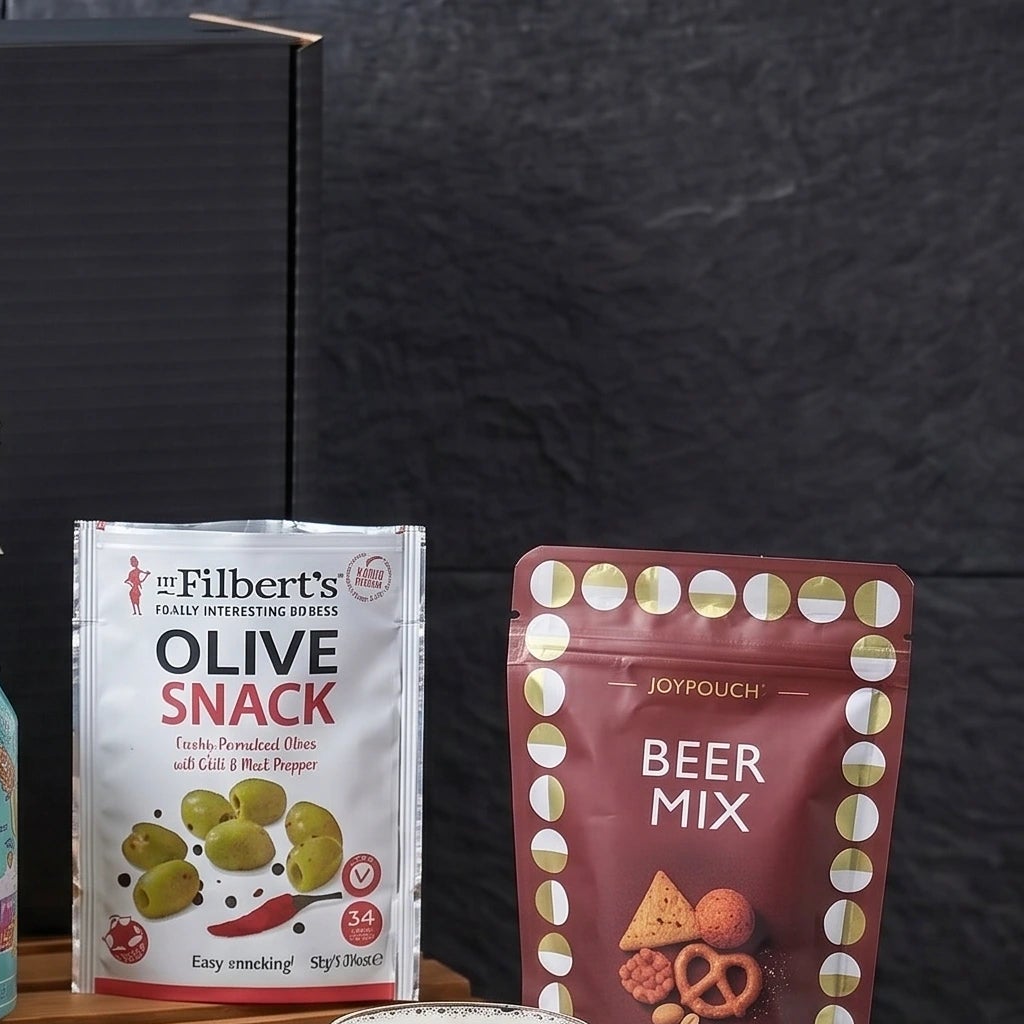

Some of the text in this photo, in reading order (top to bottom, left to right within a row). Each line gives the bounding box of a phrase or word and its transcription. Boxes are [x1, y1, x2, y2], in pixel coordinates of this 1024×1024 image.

[177, 567, 337, 599] Filbert's
[204, 605, 286, 617] INTERESTING
[156, 628, 339, 676] OLIVE
[161, 681, 337, 727] SNACK
[648, 677, 759, 699] JOYPOUCH
[642, 738, 766, 783] BEER
[650, 787, 750, 833] MIX
[348, 908, 376, 927] 34
[192, 954, 223, 974] Easy
